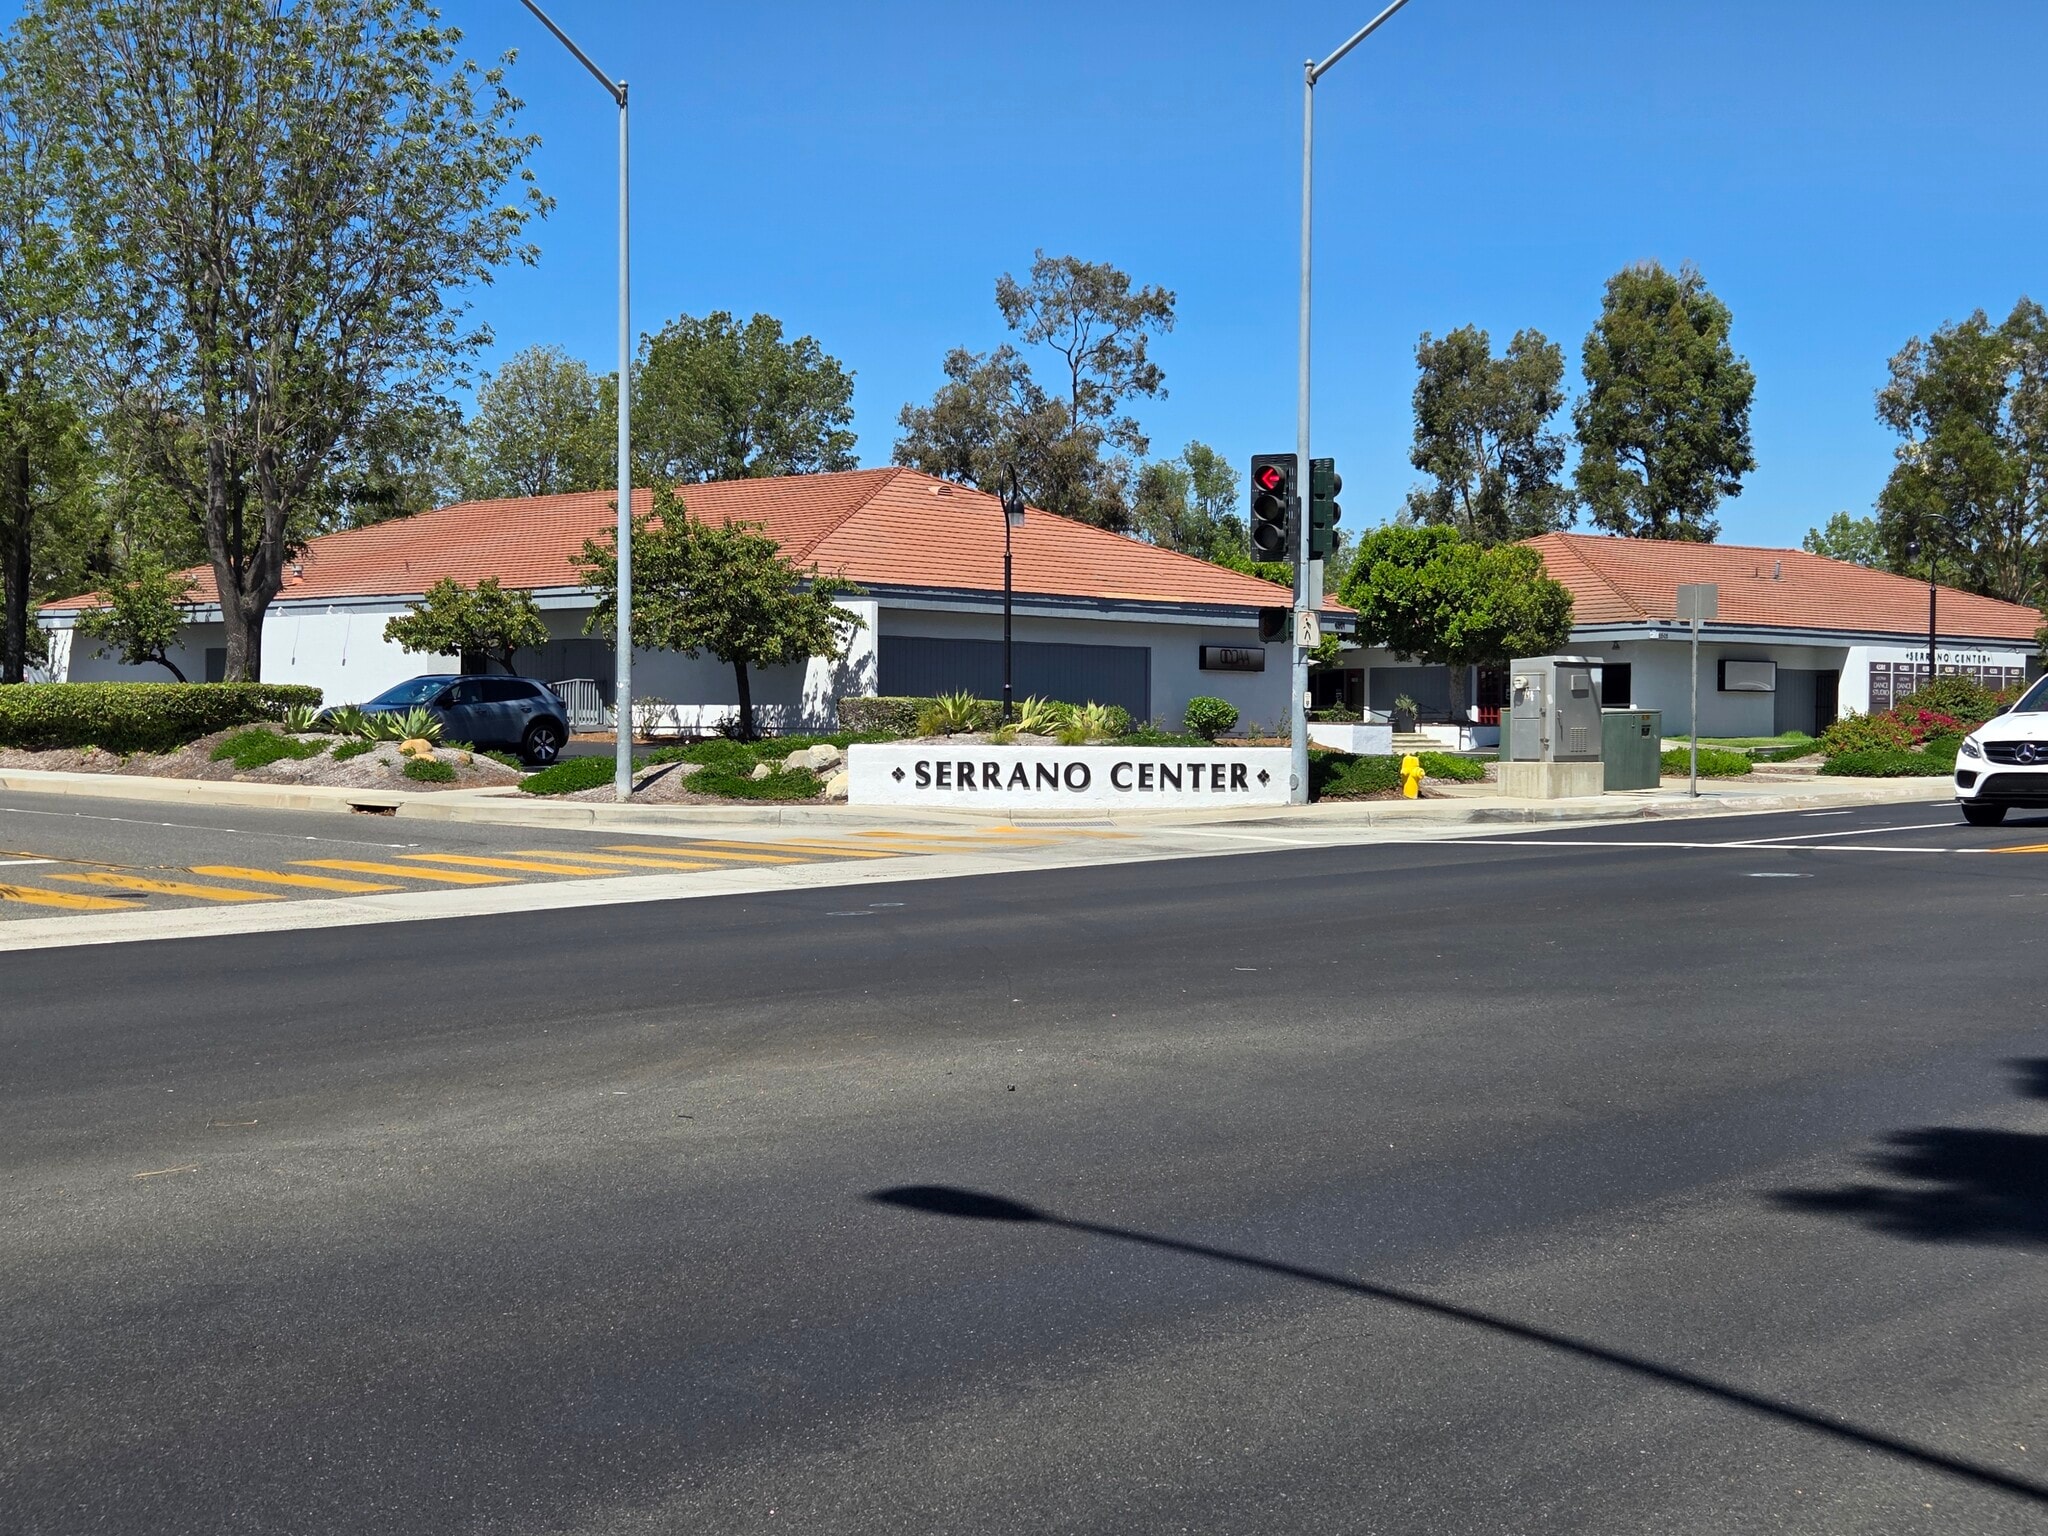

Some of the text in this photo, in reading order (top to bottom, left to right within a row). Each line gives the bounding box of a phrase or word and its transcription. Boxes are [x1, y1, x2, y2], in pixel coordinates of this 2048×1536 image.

[1909, 652, 1987, 664] SERRNO CENTER
[914, 760, 1250, 792] SERRANO CENTER
